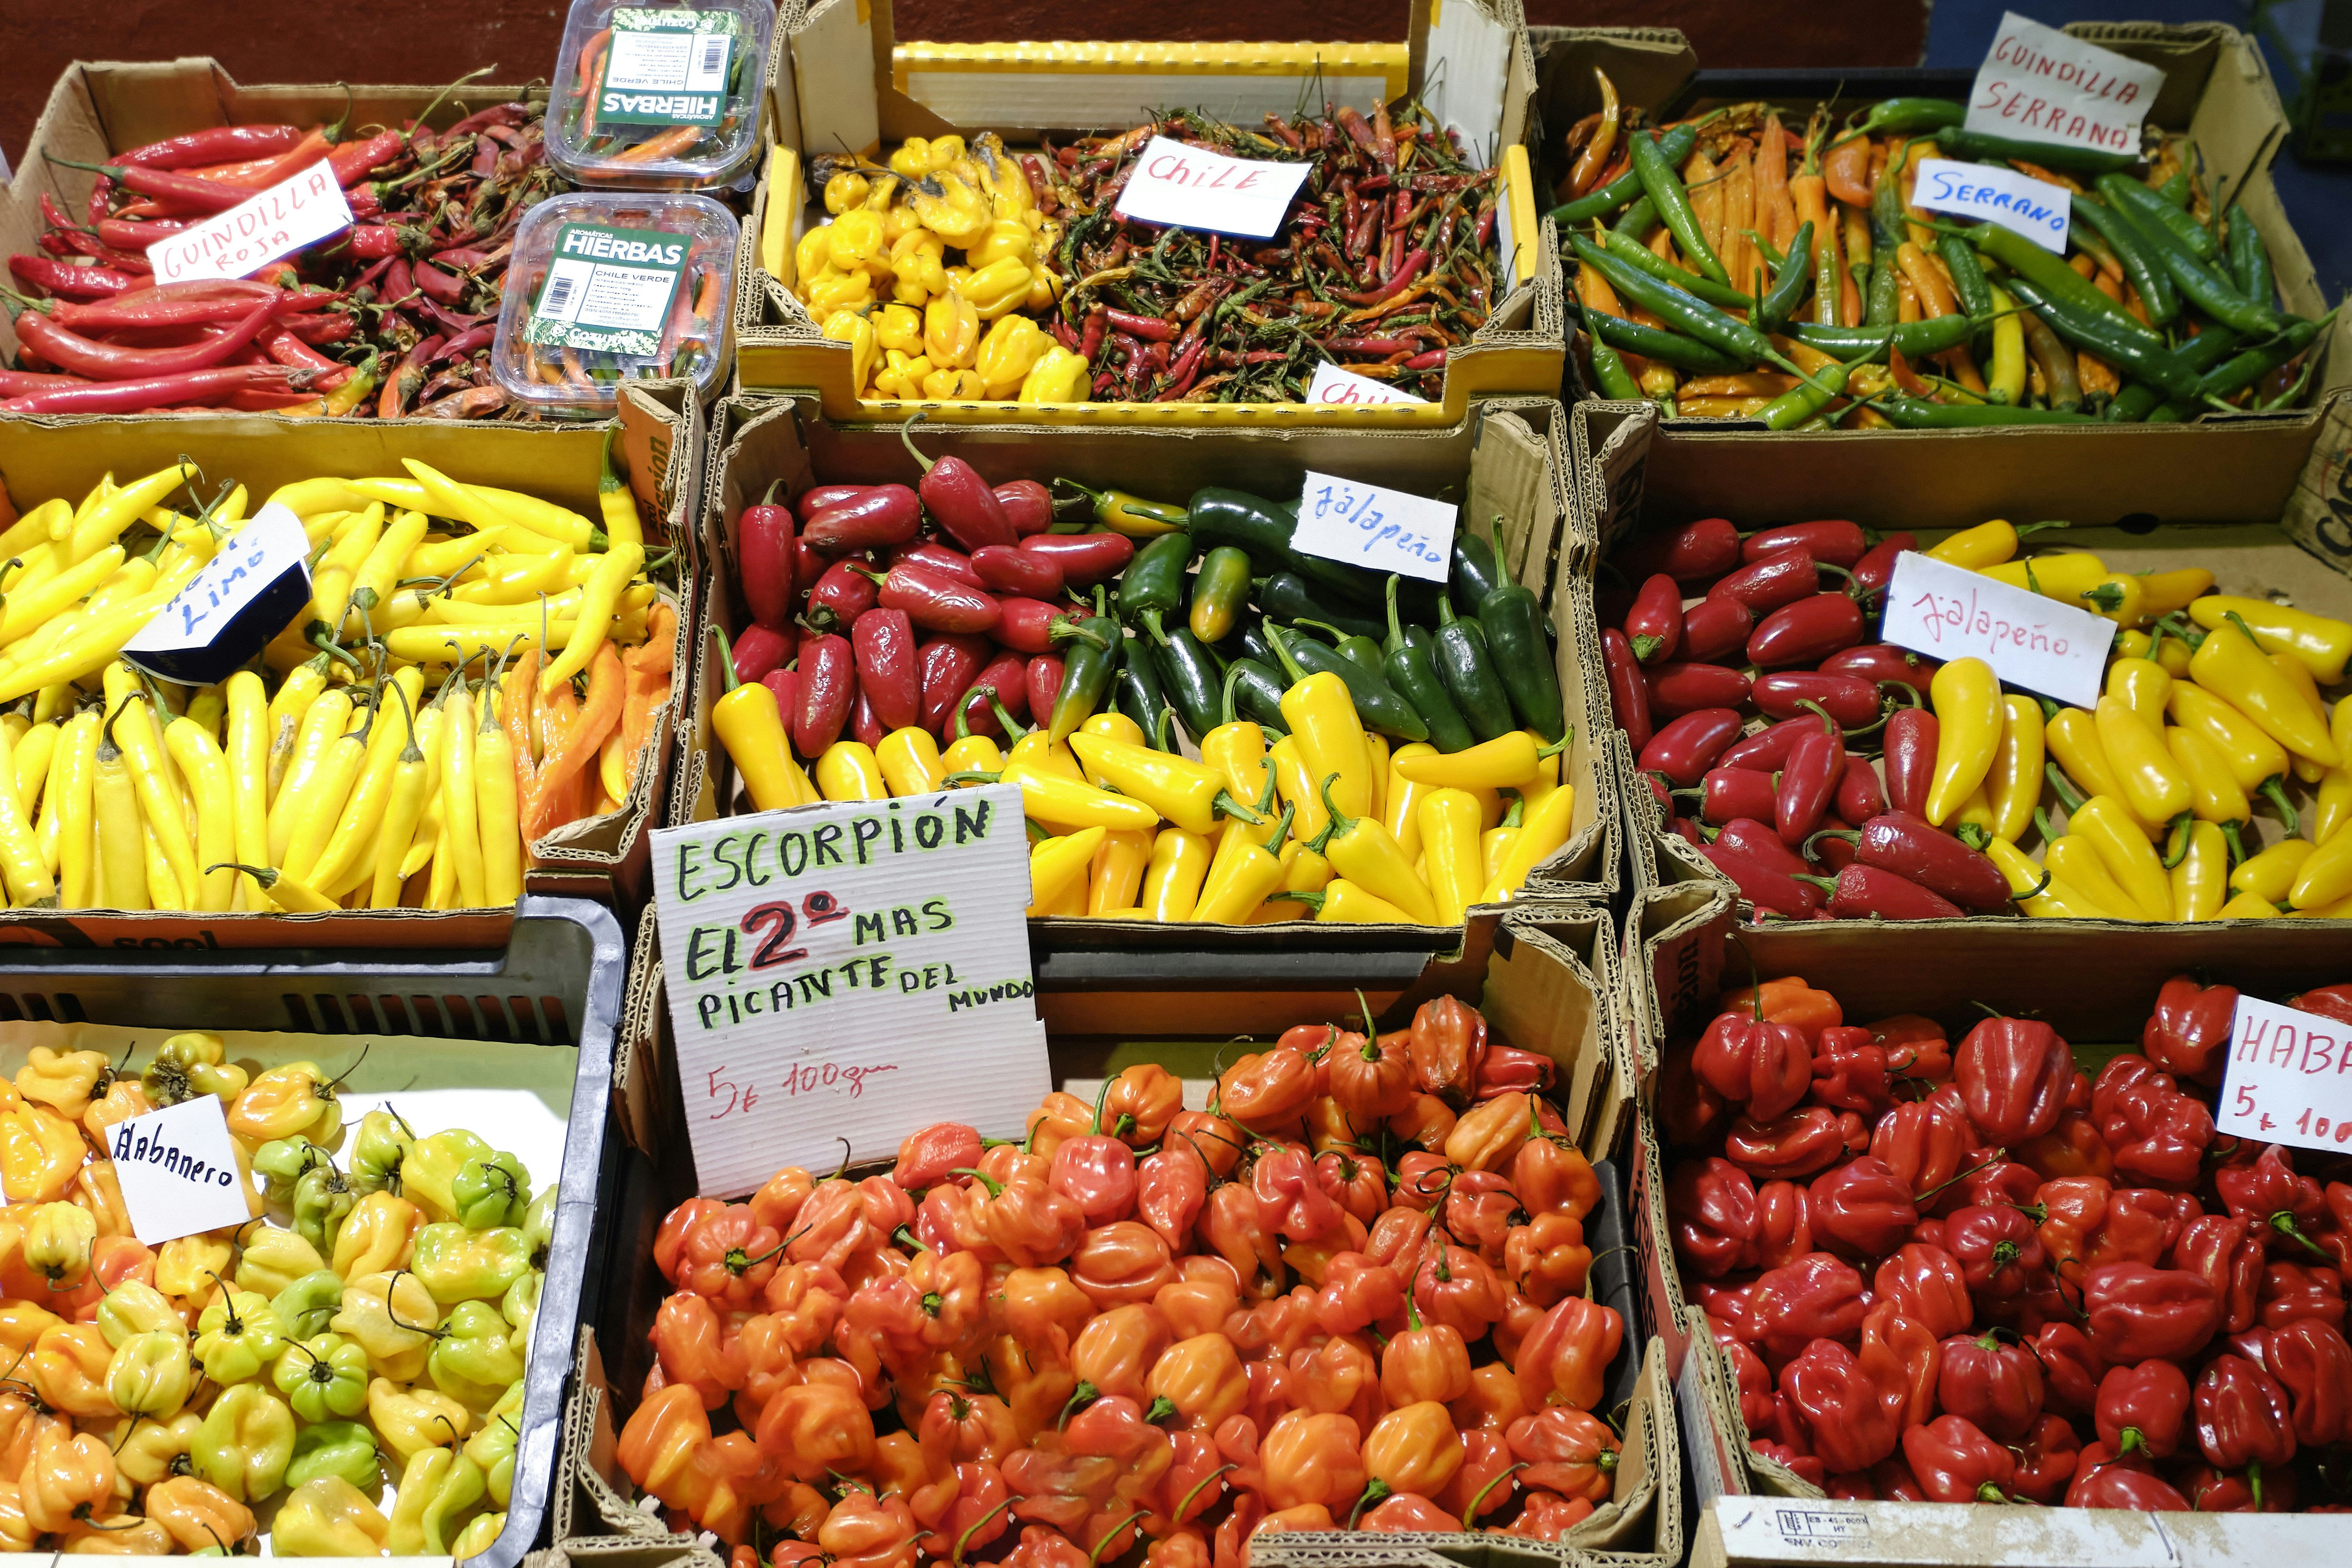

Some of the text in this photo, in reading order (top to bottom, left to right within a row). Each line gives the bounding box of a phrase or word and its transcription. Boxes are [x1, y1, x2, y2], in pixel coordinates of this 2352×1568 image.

[1996, 36, 2140, 105] GUINDILLA
[603, 93, 719, 114] HIERBAS
[1978, 81, 2128, 150] SERRANA
[1933, 172, 2065, 231] SERRANO
[164, 173, 326, 278] GUINDILLA
[569, 229, 614, 239] AROMÁTICAS
[215, 230, 289, 271] ROJA
[563, 234, 683, 265] HIERBAS
[596, 270, 670, 283] CHILE VERDE
[678, 796, 991, 901] ESCORPIÓN
[854, 900, 954, 946] MAS
[698, 955, 959, 1029] PICANTE DEL
[948, 979, 1035, 1013] MUNDO
